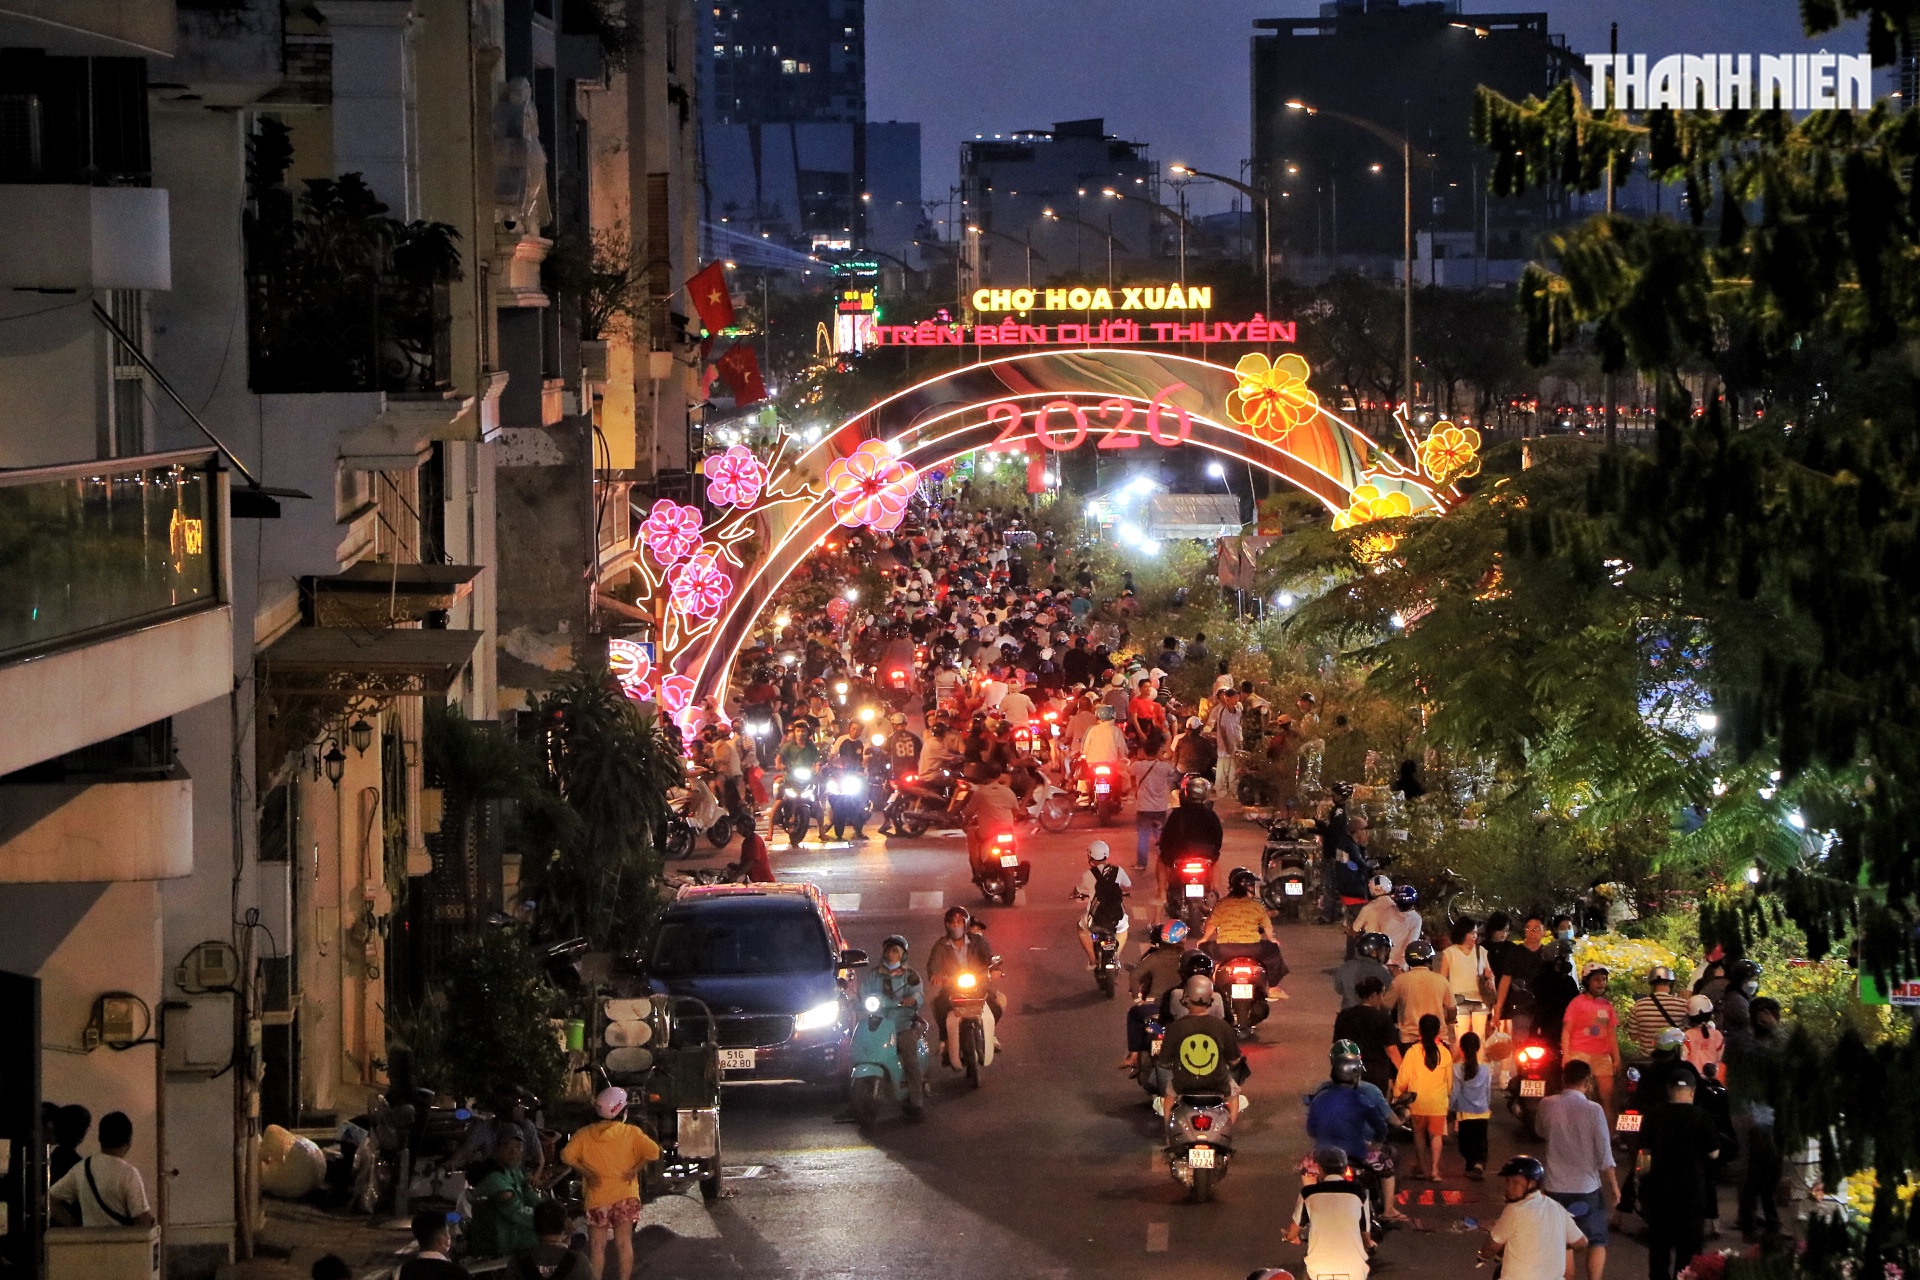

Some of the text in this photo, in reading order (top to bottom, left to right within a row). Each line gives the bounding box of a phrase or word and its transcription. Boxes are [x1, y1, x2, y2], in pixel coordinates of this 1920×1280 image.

[972, 282, 1211, 317] CHỢ HOA XUÂN
[870, 320, 965, 346] TRÊN
[974, 315, 1047, 345] BẾN
[1150, 311, 1297, 343] THUYỀN
[986, 382, 1193, 454] 2026
[895, 740, 915, 758] 88
[720, 1059, 751, 1068] 842.80
[727, 1050, 744, 1060] 51G
